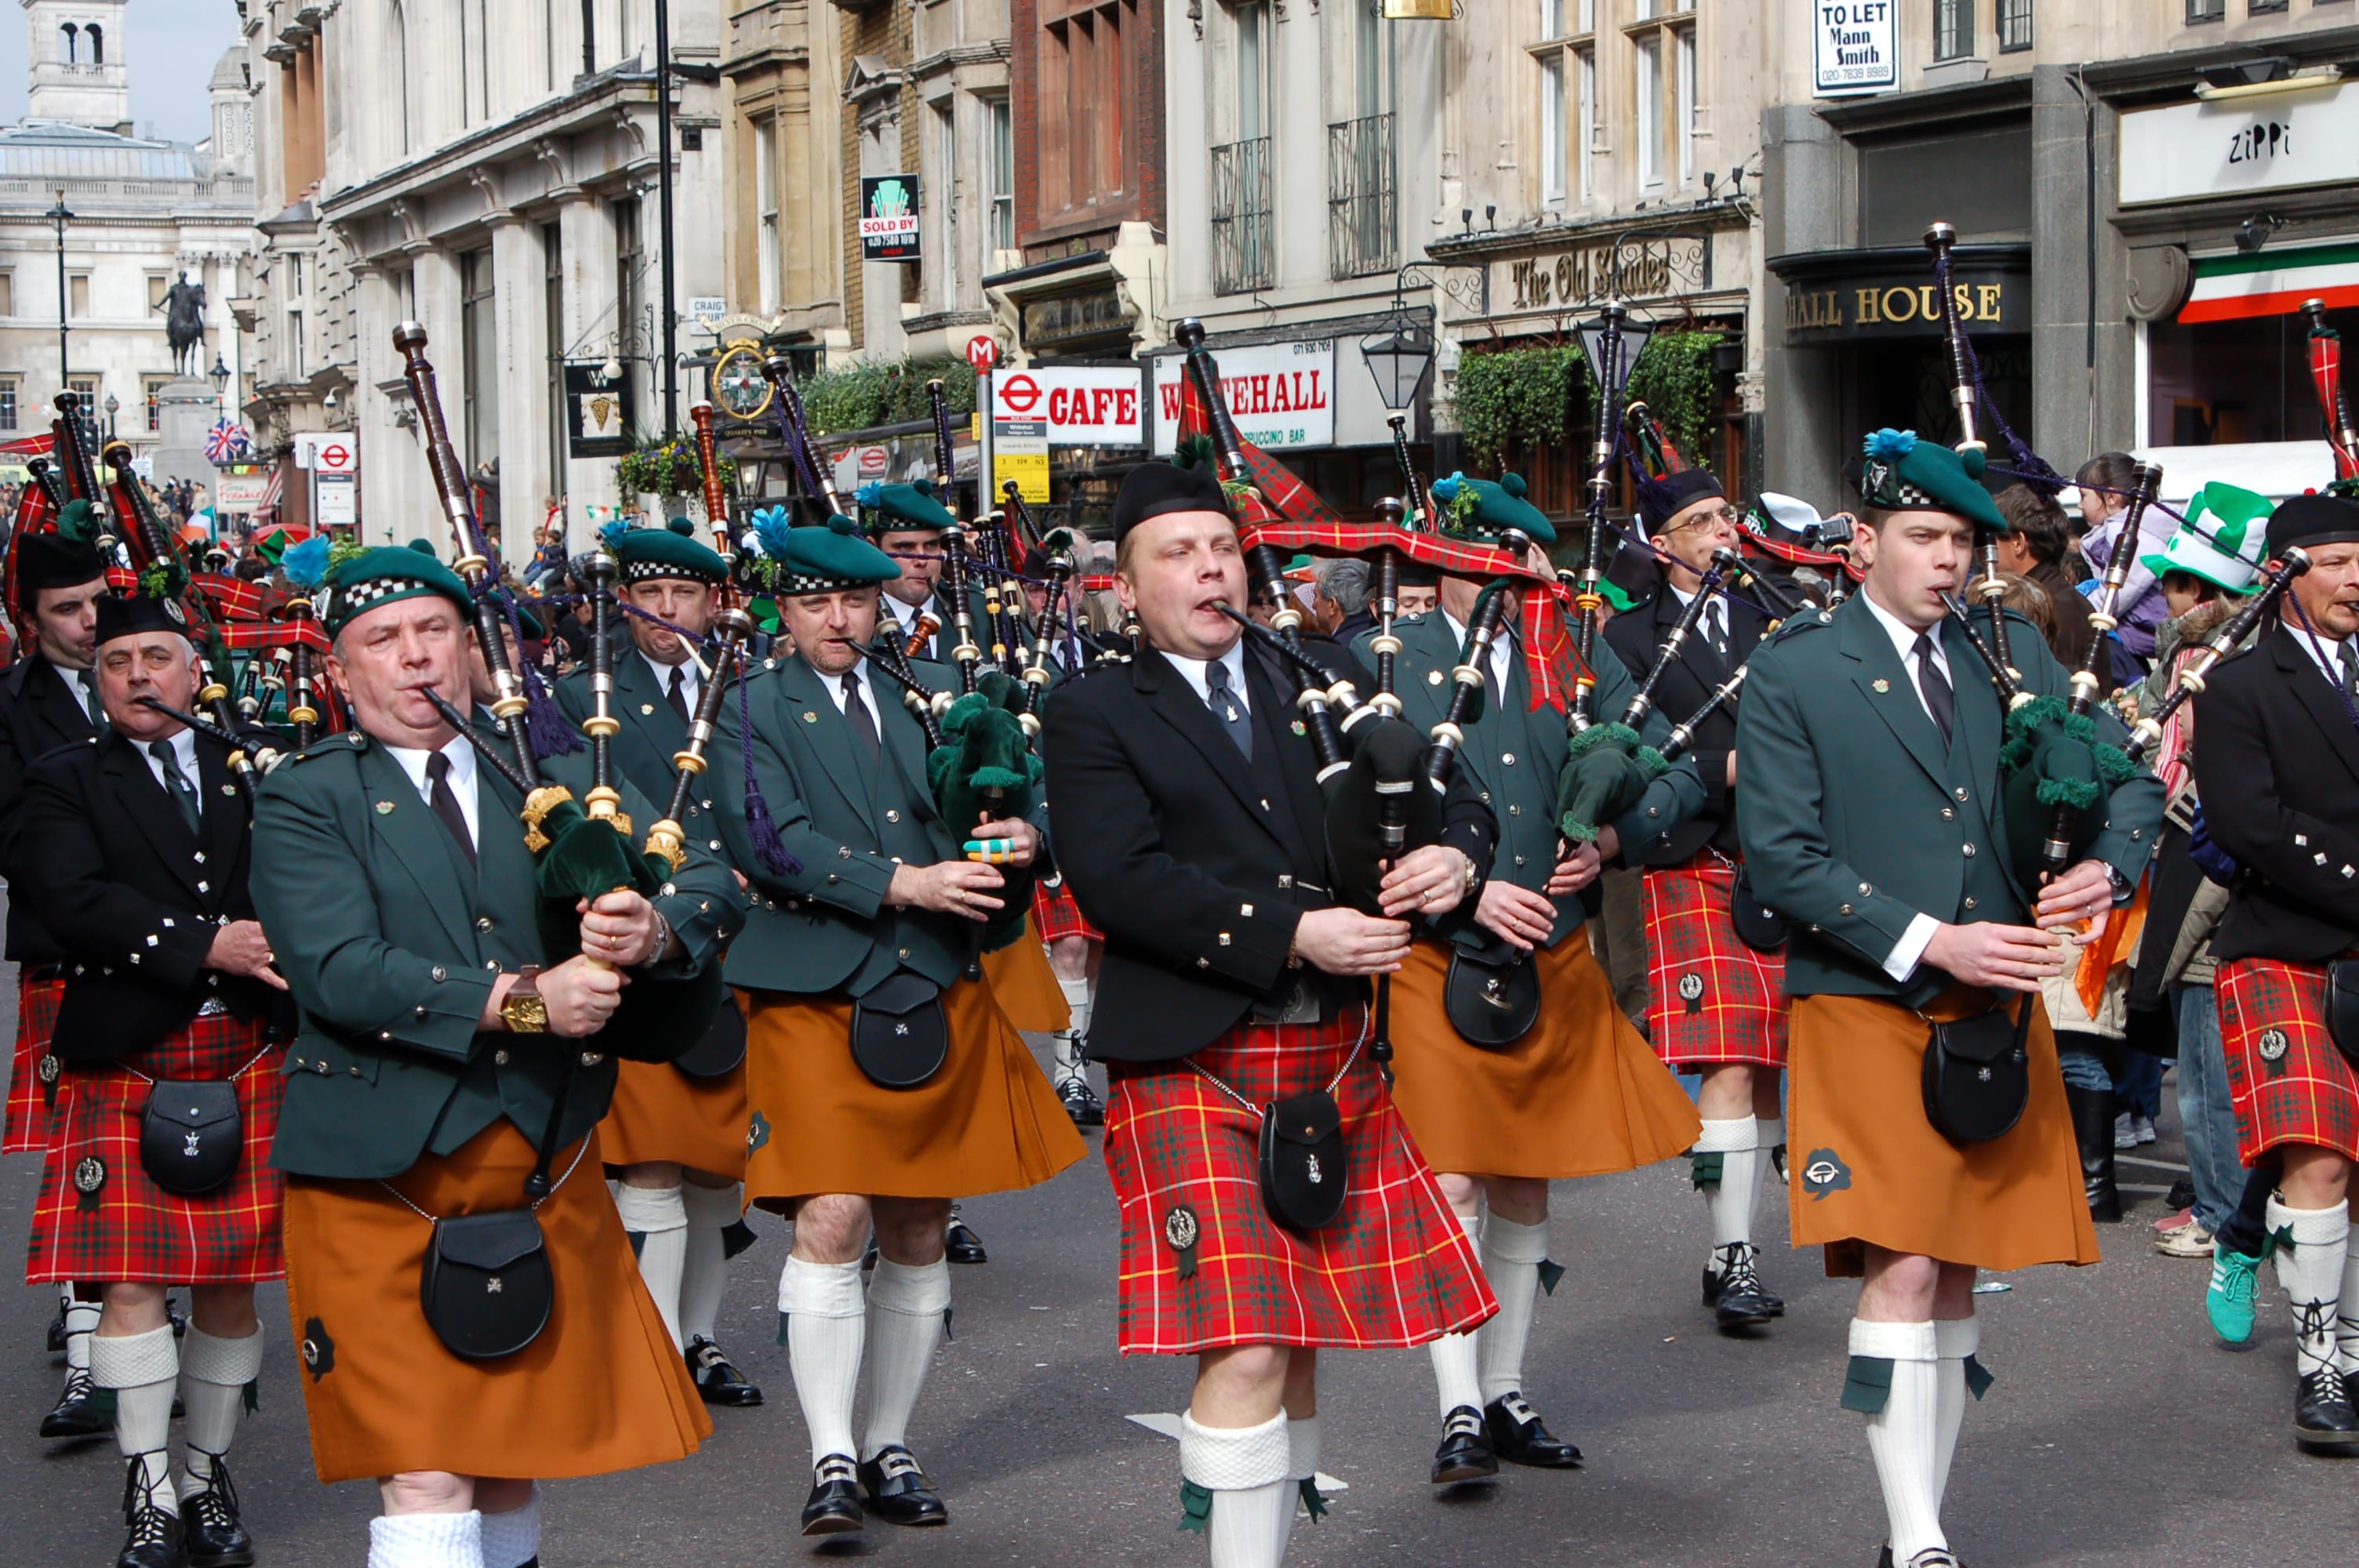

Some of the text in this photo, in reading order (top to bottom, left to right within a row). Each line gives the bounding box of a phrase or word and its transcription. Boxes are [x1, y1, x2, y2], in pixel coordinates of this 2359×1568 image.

[1823, 3, 1886, 25] TO LET
[1830, 27, 1870, 45] Mann
[1837, 45, 1879, 65] Smith
[1866, 66, 1889, 78] 8989
[863, 220, 914, 233] SOLD BY
[1512, 242, 1670, 308] The Old Shades
[1787, 283, 2001, 329] HALL HOUSE
[972, 340, 993, 362] M
[1160, 370, 1325, 420] WEHALL
[1244, 428, 1305, 445] PUCCINO BAR
